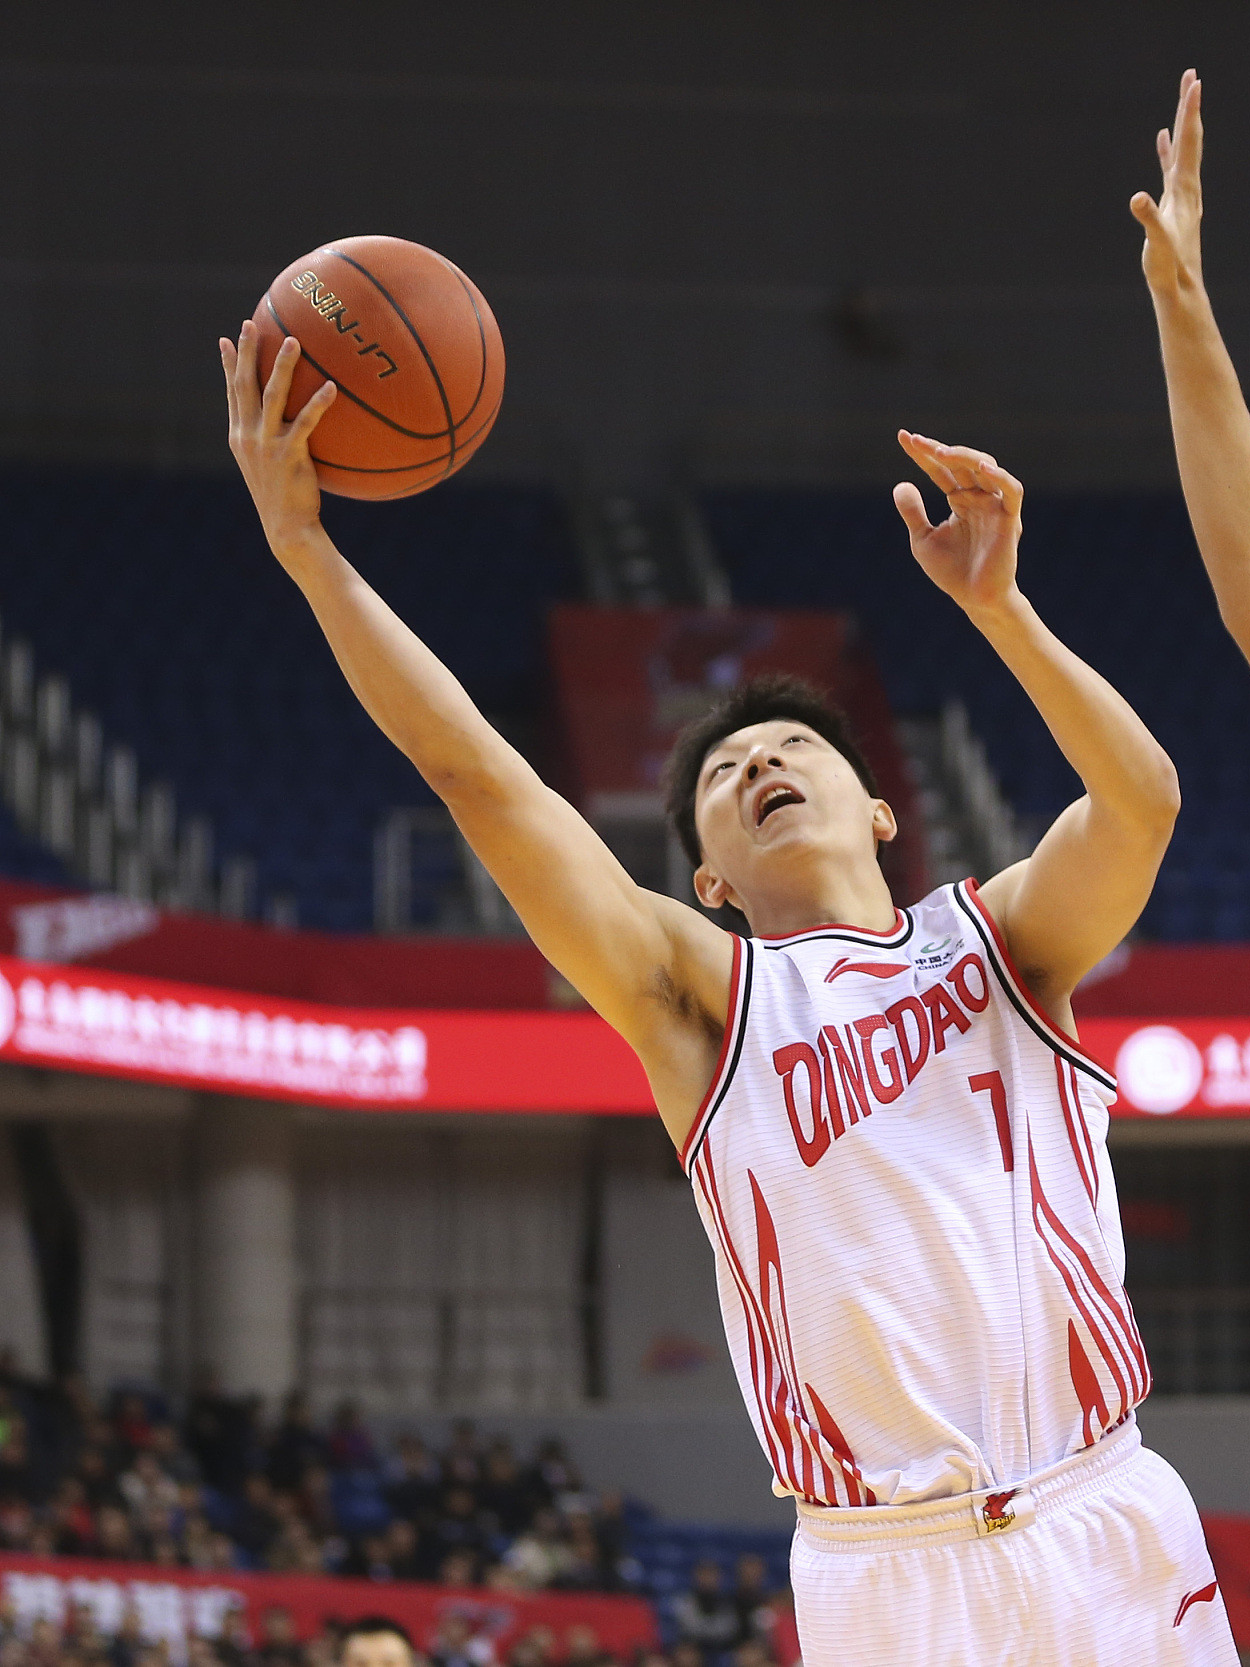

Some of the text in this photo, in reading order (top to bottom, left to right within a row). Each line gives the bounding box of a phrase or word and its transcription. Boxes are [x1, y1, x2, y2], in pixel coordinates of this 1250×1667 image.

[290, 270, 398, 379] LI-NING
[773, 952, 989, 1168] QINGDAO
[968, 1070, 1014, 1172] 7
